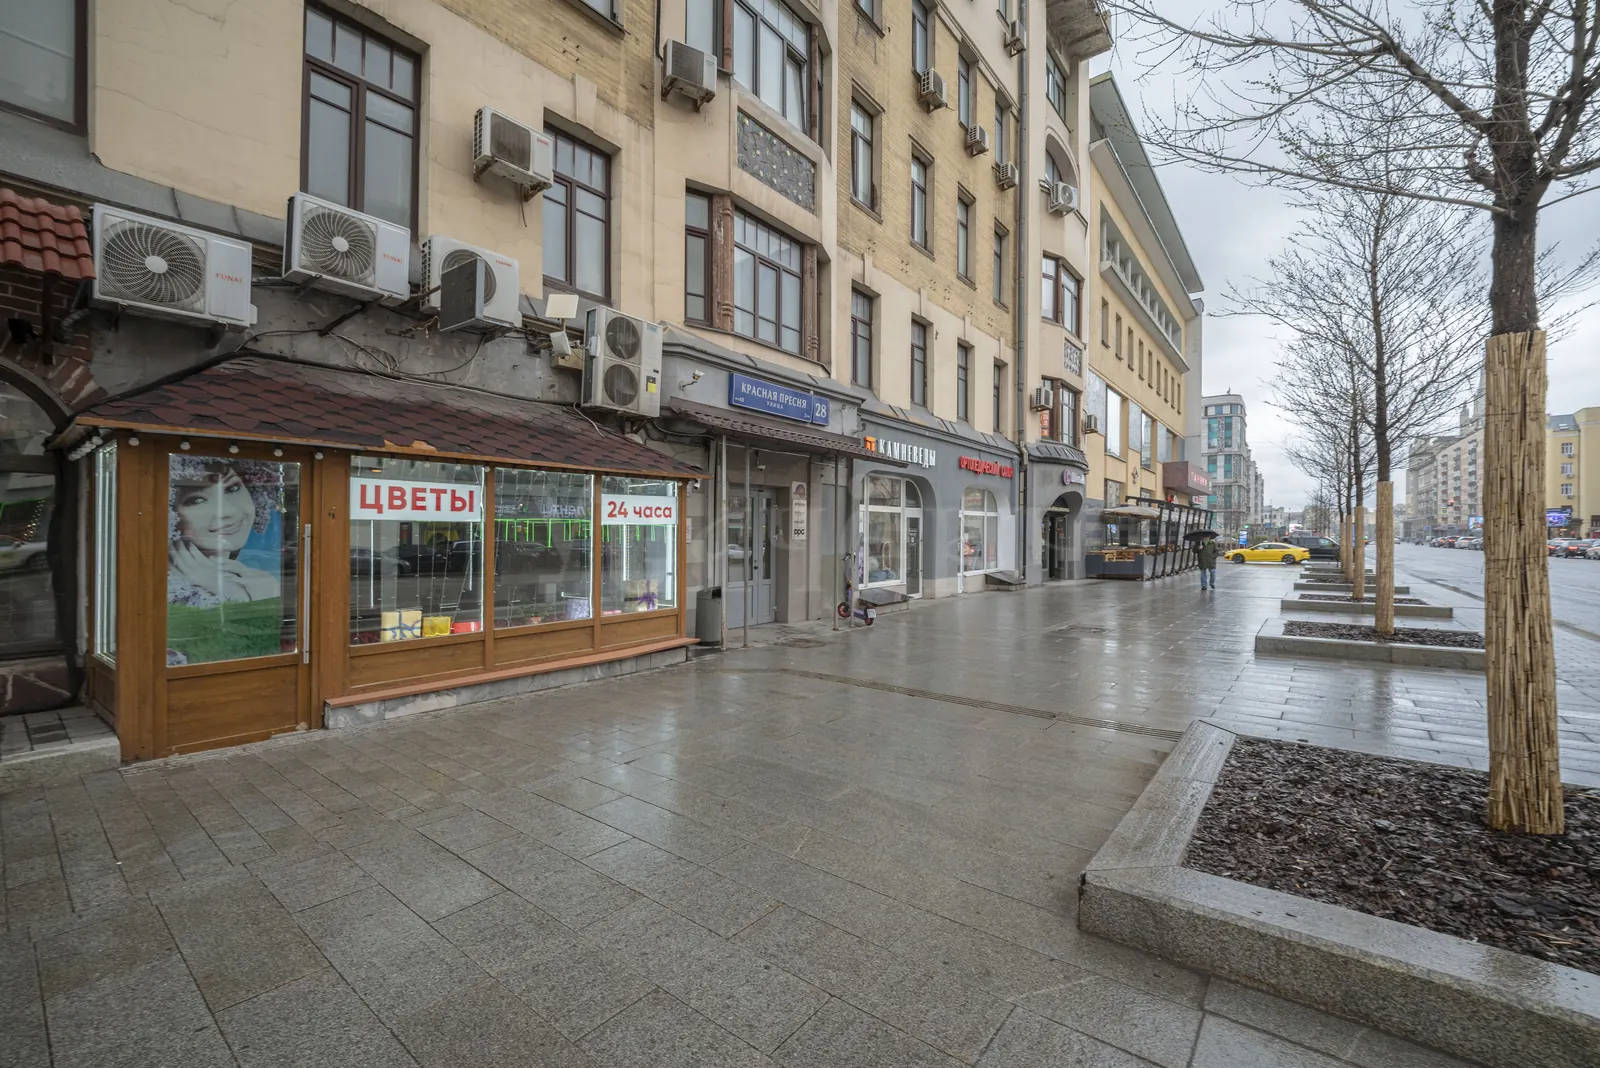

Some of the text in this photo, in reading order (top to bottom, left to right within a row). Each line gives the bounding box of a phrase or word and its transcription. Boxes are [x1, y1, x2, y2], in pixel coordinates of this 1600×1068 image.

[383, 253, 403, 264] FUNAI
[215, 272, 243, 284] FUNAI
[741, 382, 807, 409] КРАСНАЯ ПРЕСНЯ
[766, 401, 784, 410] УЛИЦА
[815, 402, 827, 418] 28
[879, 438, 936, 469] КАМНЕВЕДЫ
[959, 455, 1000, 476] ОРТОПЕДИЧЕСКИЙ
[360, 484, 475, 514] ЦВЕТЫ
[607, 500, 672, 519] 24 часа
